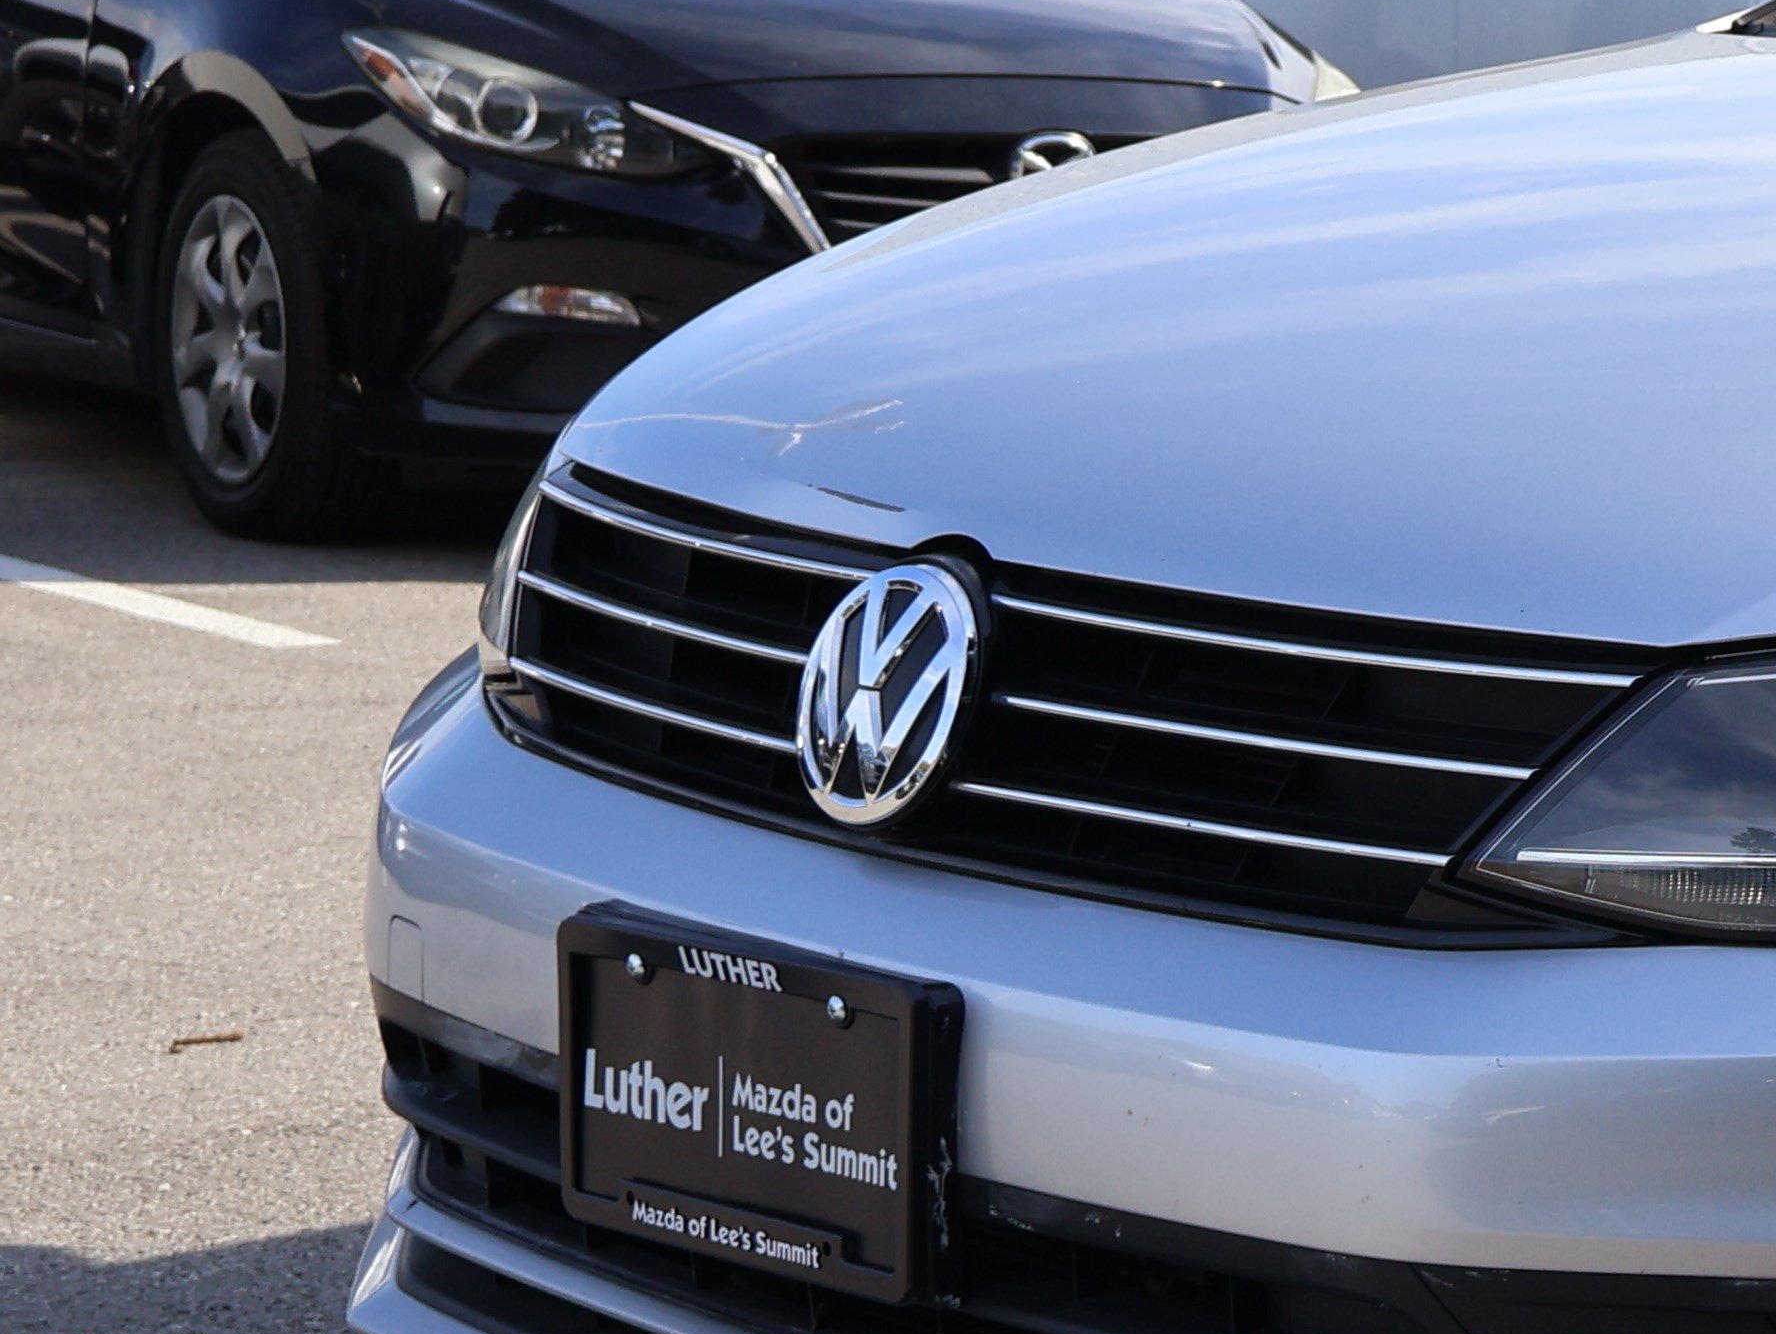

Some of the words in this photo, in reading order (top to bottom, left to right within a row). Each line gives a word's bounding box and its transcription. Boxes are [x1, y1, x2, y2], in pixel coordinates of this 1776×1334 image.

[677, 945, 783, 993] LUTHER
[584, 1048, 709, 1131] Luther
[732, 1071, 817, 1124] Mazda
[825, 1093, 854, 1131] of
[732, 1115, 795, 1165] Lee's
[803, 1132, 898, 1191] Summit
[632, 1199, 684, 1235] Mazda
[688, 1216, 707, 1239] of
[710, 1219, 751, 1251] Lee's
[755, 1231, 821, 1269] Summit
